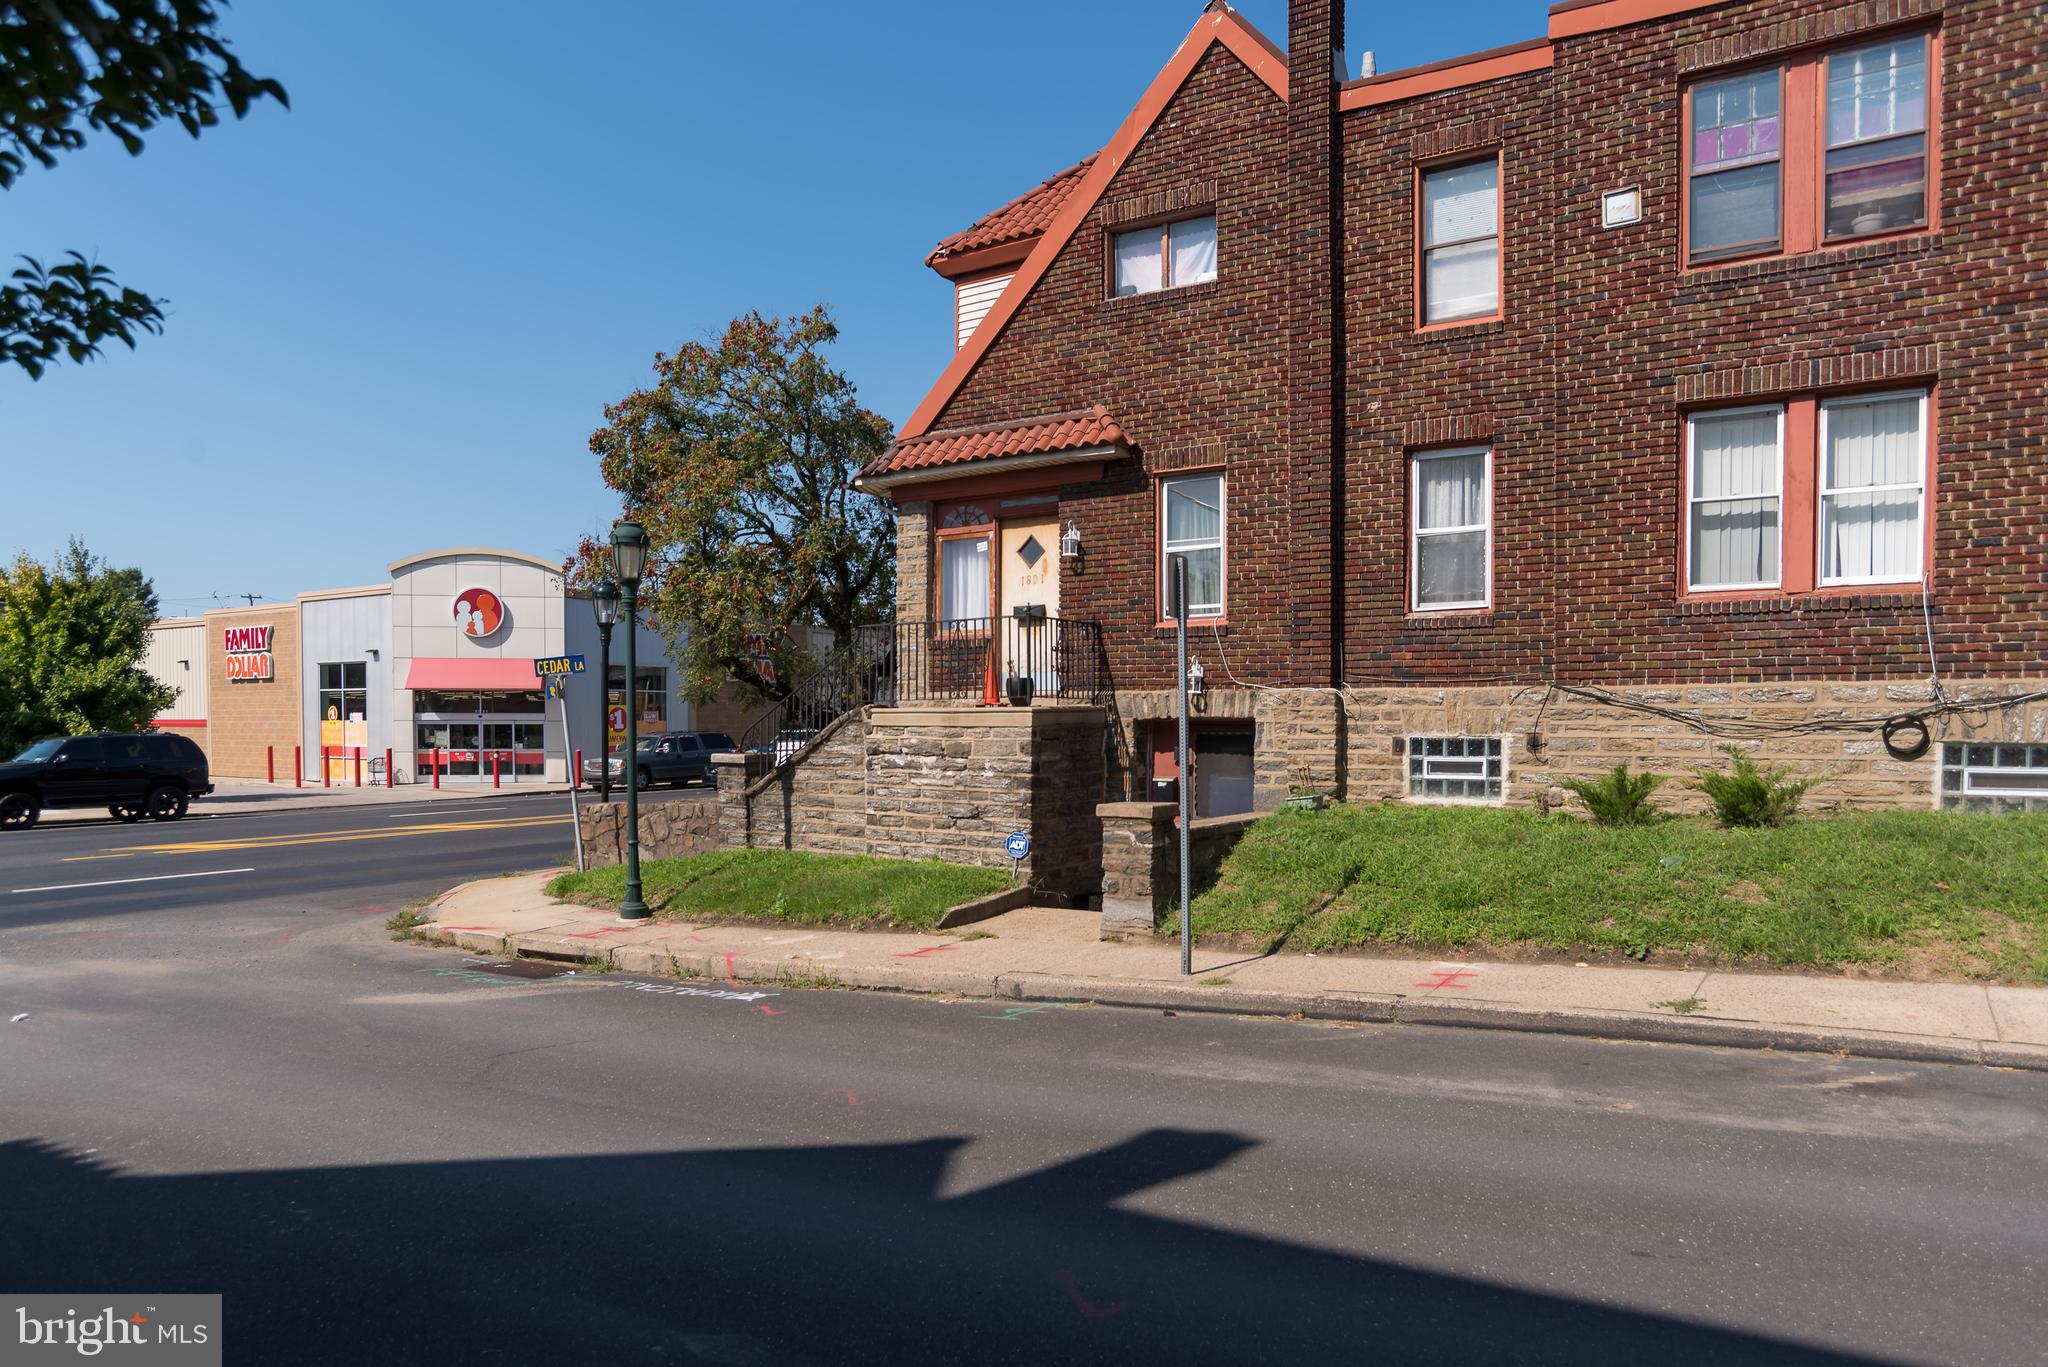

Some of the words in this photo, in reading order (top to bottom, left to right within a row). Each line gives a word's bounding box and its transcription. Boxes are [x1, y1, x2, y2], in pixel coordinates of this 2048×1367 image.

[224, 626, 269, 651] FAMILY
[226, 653, 269, 678] DOLLAR
[537, 658, 571, 675] CEDAR
[574, 661, 585, 671] LA
[609, 709, 625, 730] $1
[1009, 840, 1025, 850] ADT
